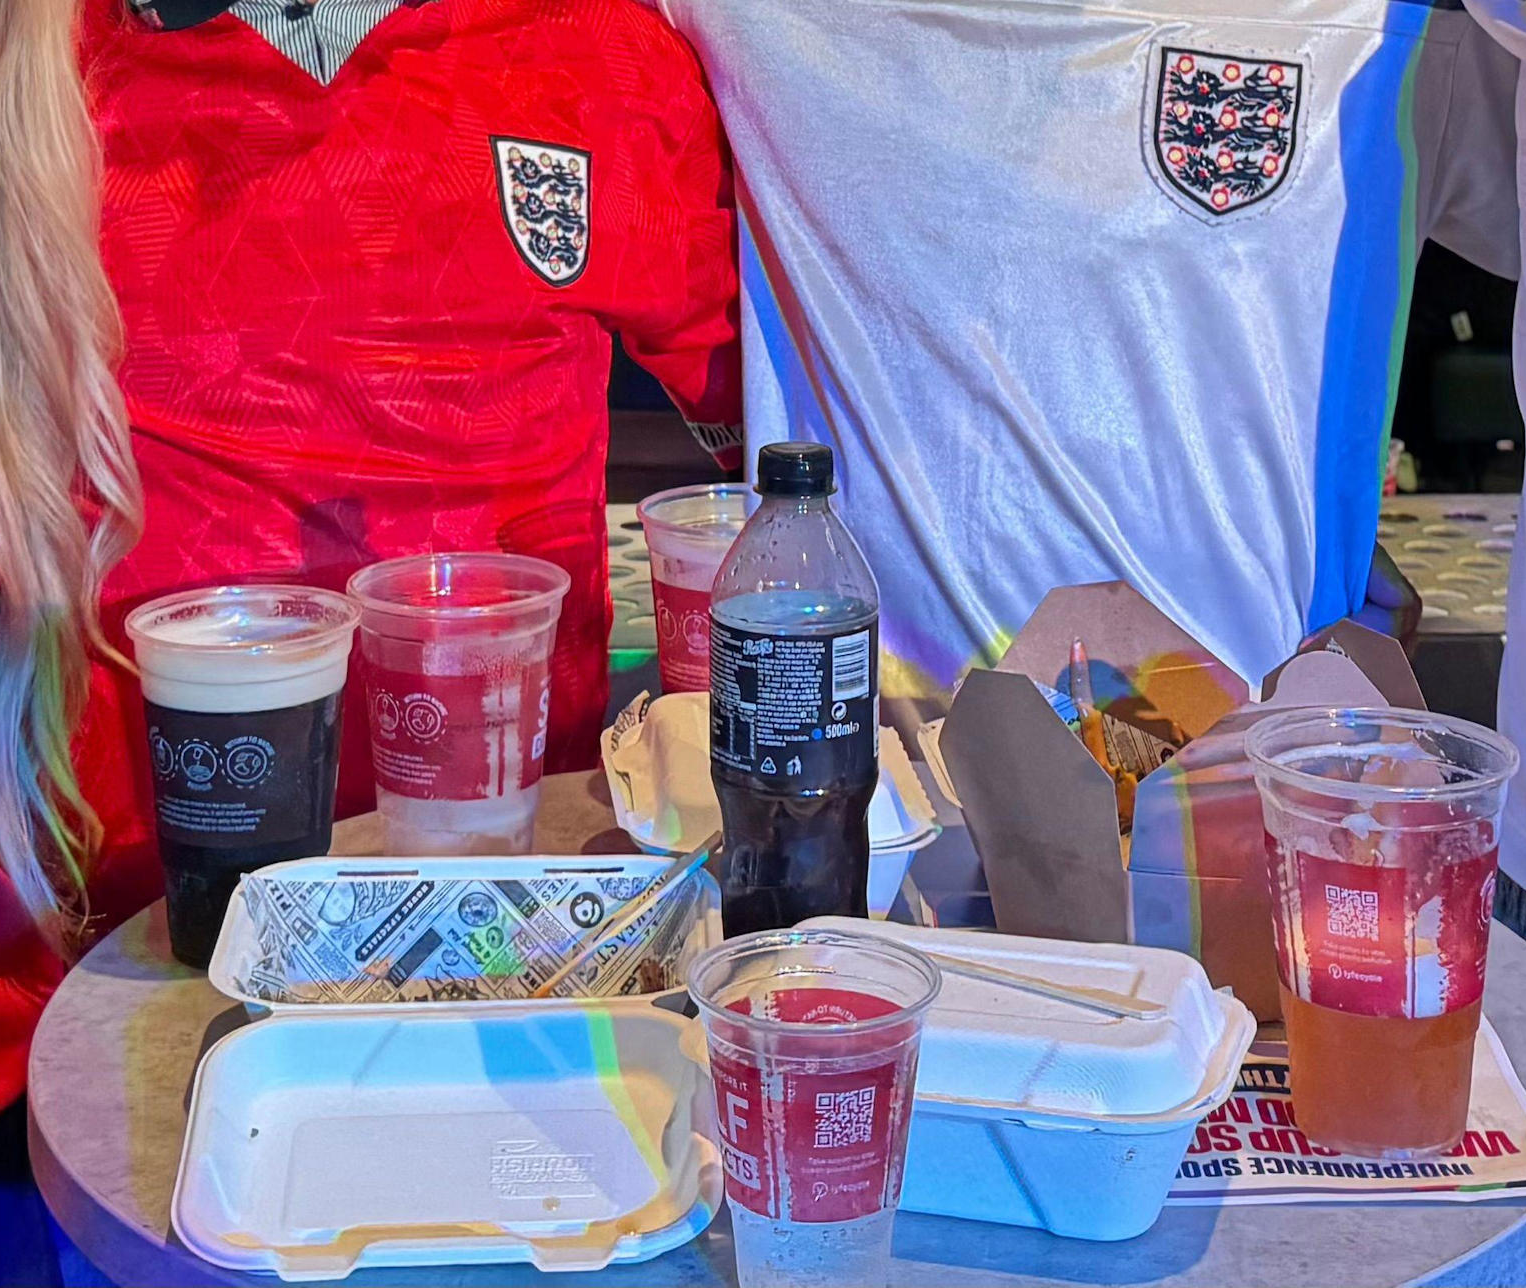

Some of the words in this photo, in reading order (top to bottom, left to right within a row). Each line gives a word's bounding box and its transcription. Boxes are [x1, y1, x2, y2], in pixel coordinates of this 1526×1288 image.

[401, 884, 429, 915] HOUSE
[361, 913, 402, 955] SPECIALS
[1249, 1157, 1475, 1179] INDEPENDENCE
